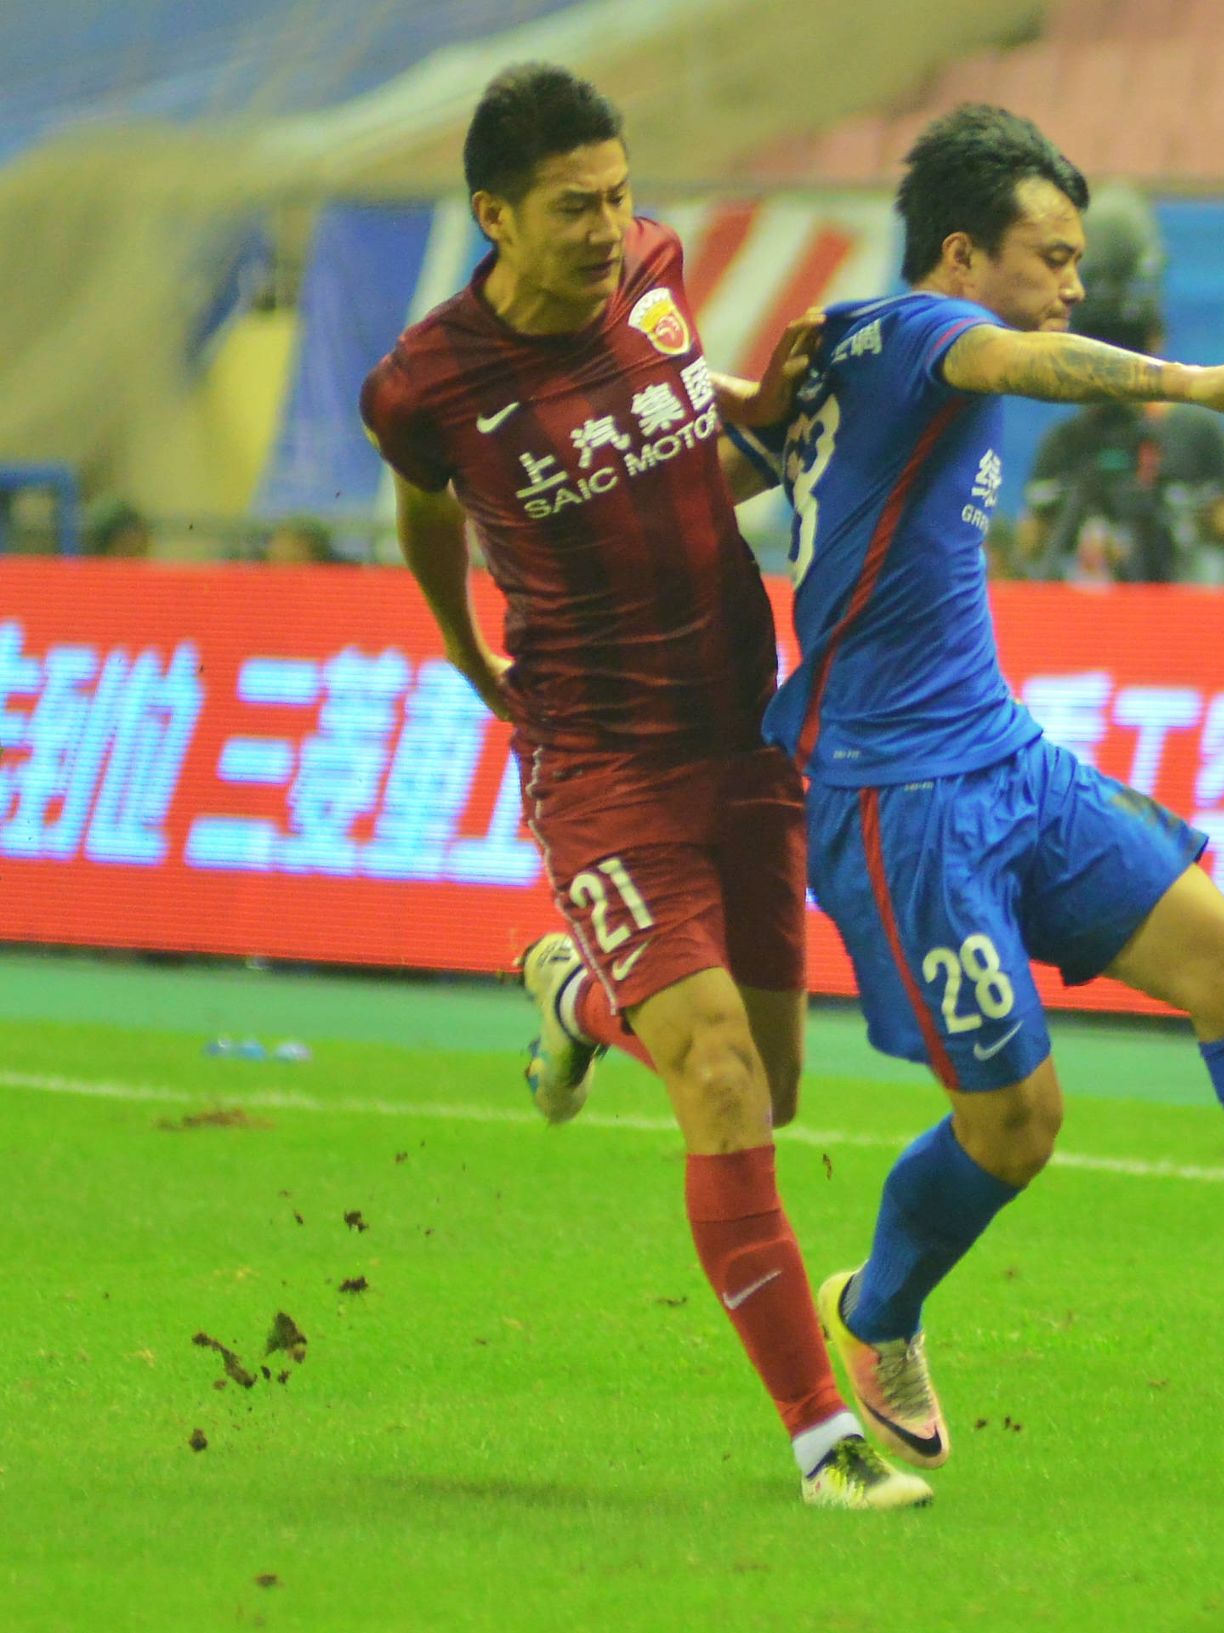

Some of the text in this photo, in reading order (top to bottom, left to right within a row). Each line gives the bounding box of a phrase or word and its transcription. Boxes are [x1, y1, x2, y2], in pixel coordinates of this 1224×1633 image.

[524, 466, 619, 519] SAIC
[570, 857, 653, 953] 21
[922, 933, 1015, 1034] 28
